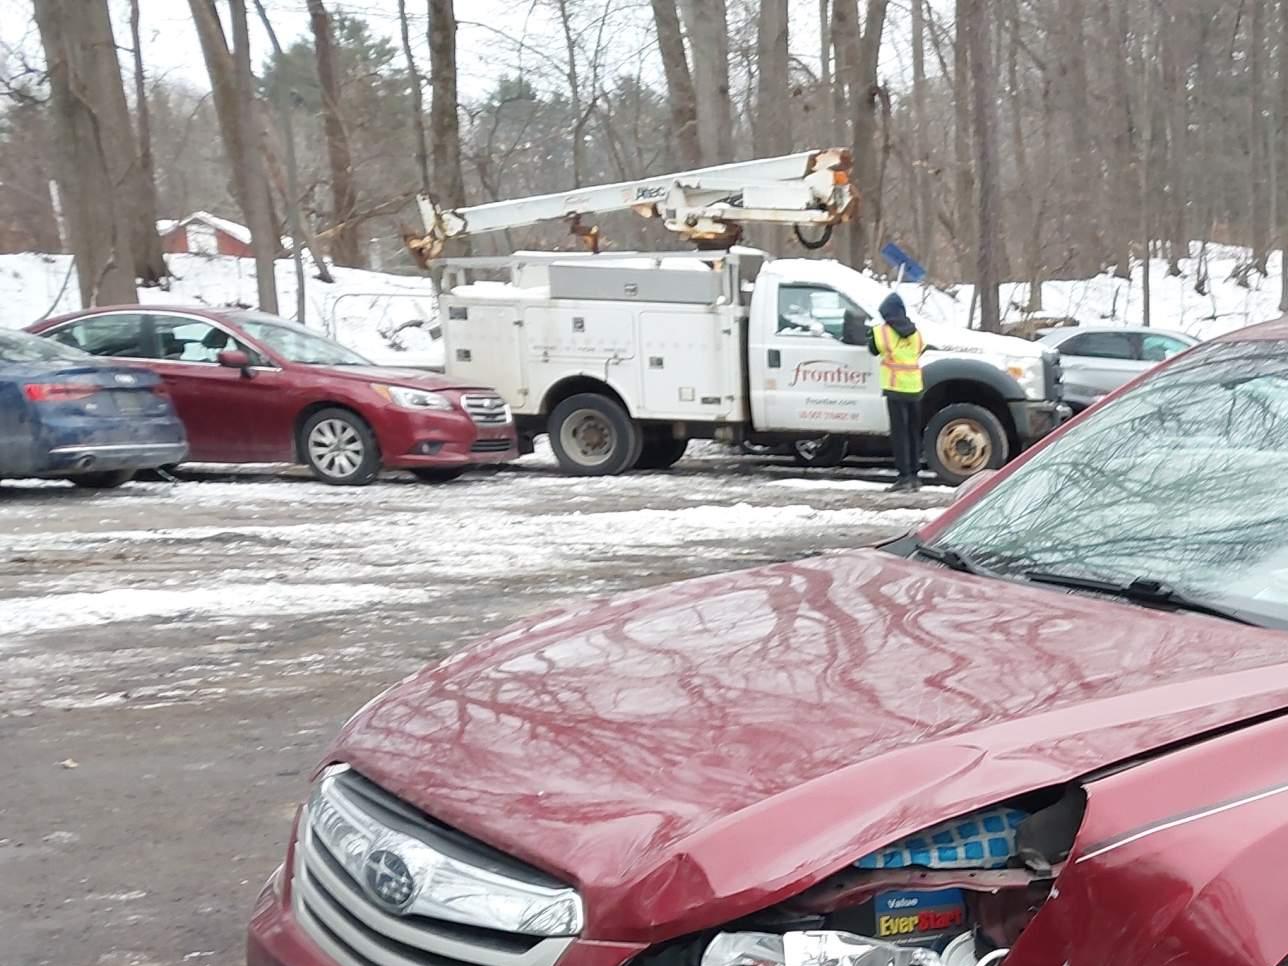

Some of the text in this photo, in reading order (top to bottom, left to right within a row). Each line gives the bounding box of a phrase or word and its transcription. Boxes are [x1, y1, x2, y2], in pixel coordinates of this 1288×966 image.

[788, 360, 872, 387] frontier
[888, 897, 919, 909] Value
[880, 908, 961, 937] EverStart
